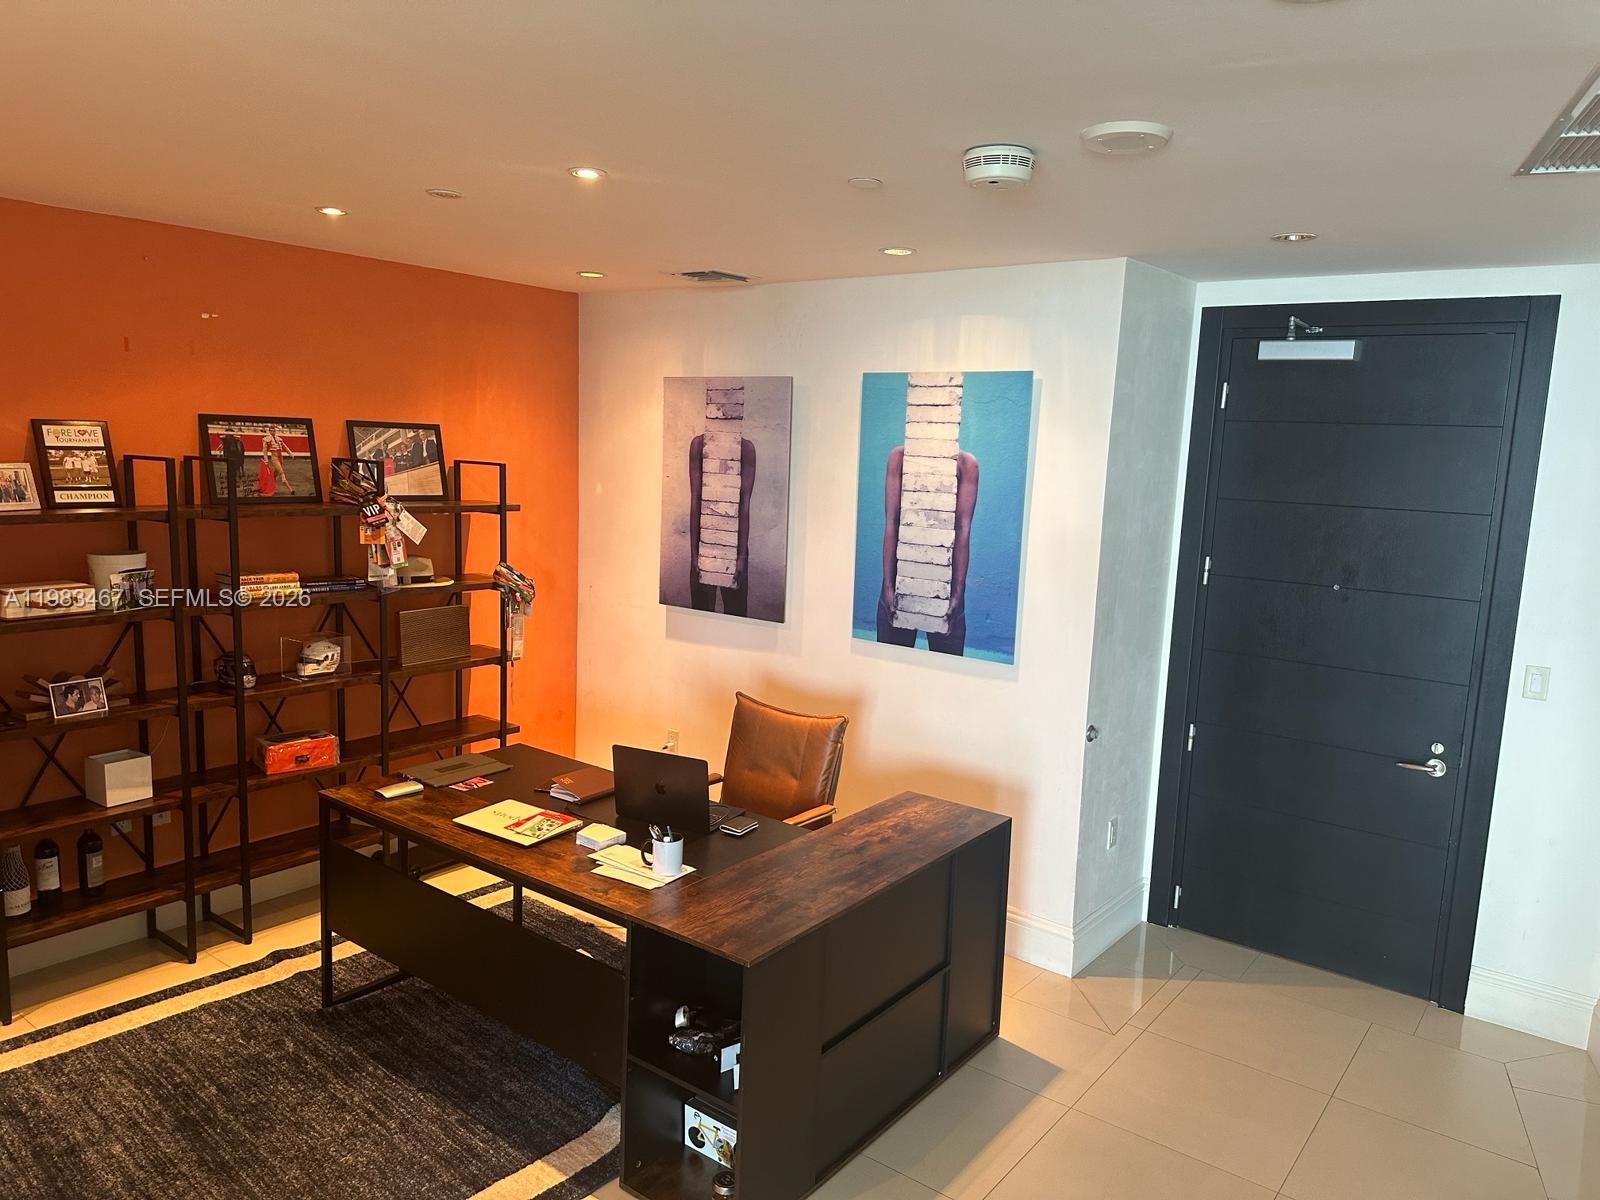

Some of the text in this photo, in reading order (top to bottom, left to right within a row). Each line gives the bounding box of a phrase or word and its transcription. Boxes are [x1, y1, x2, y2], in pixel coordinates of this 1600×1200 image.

[47, 428, 98, 437] FORE LOVE
[55, 436, 99, 444] TOURNAMENT
[362, 504, 380, 517] VIP
